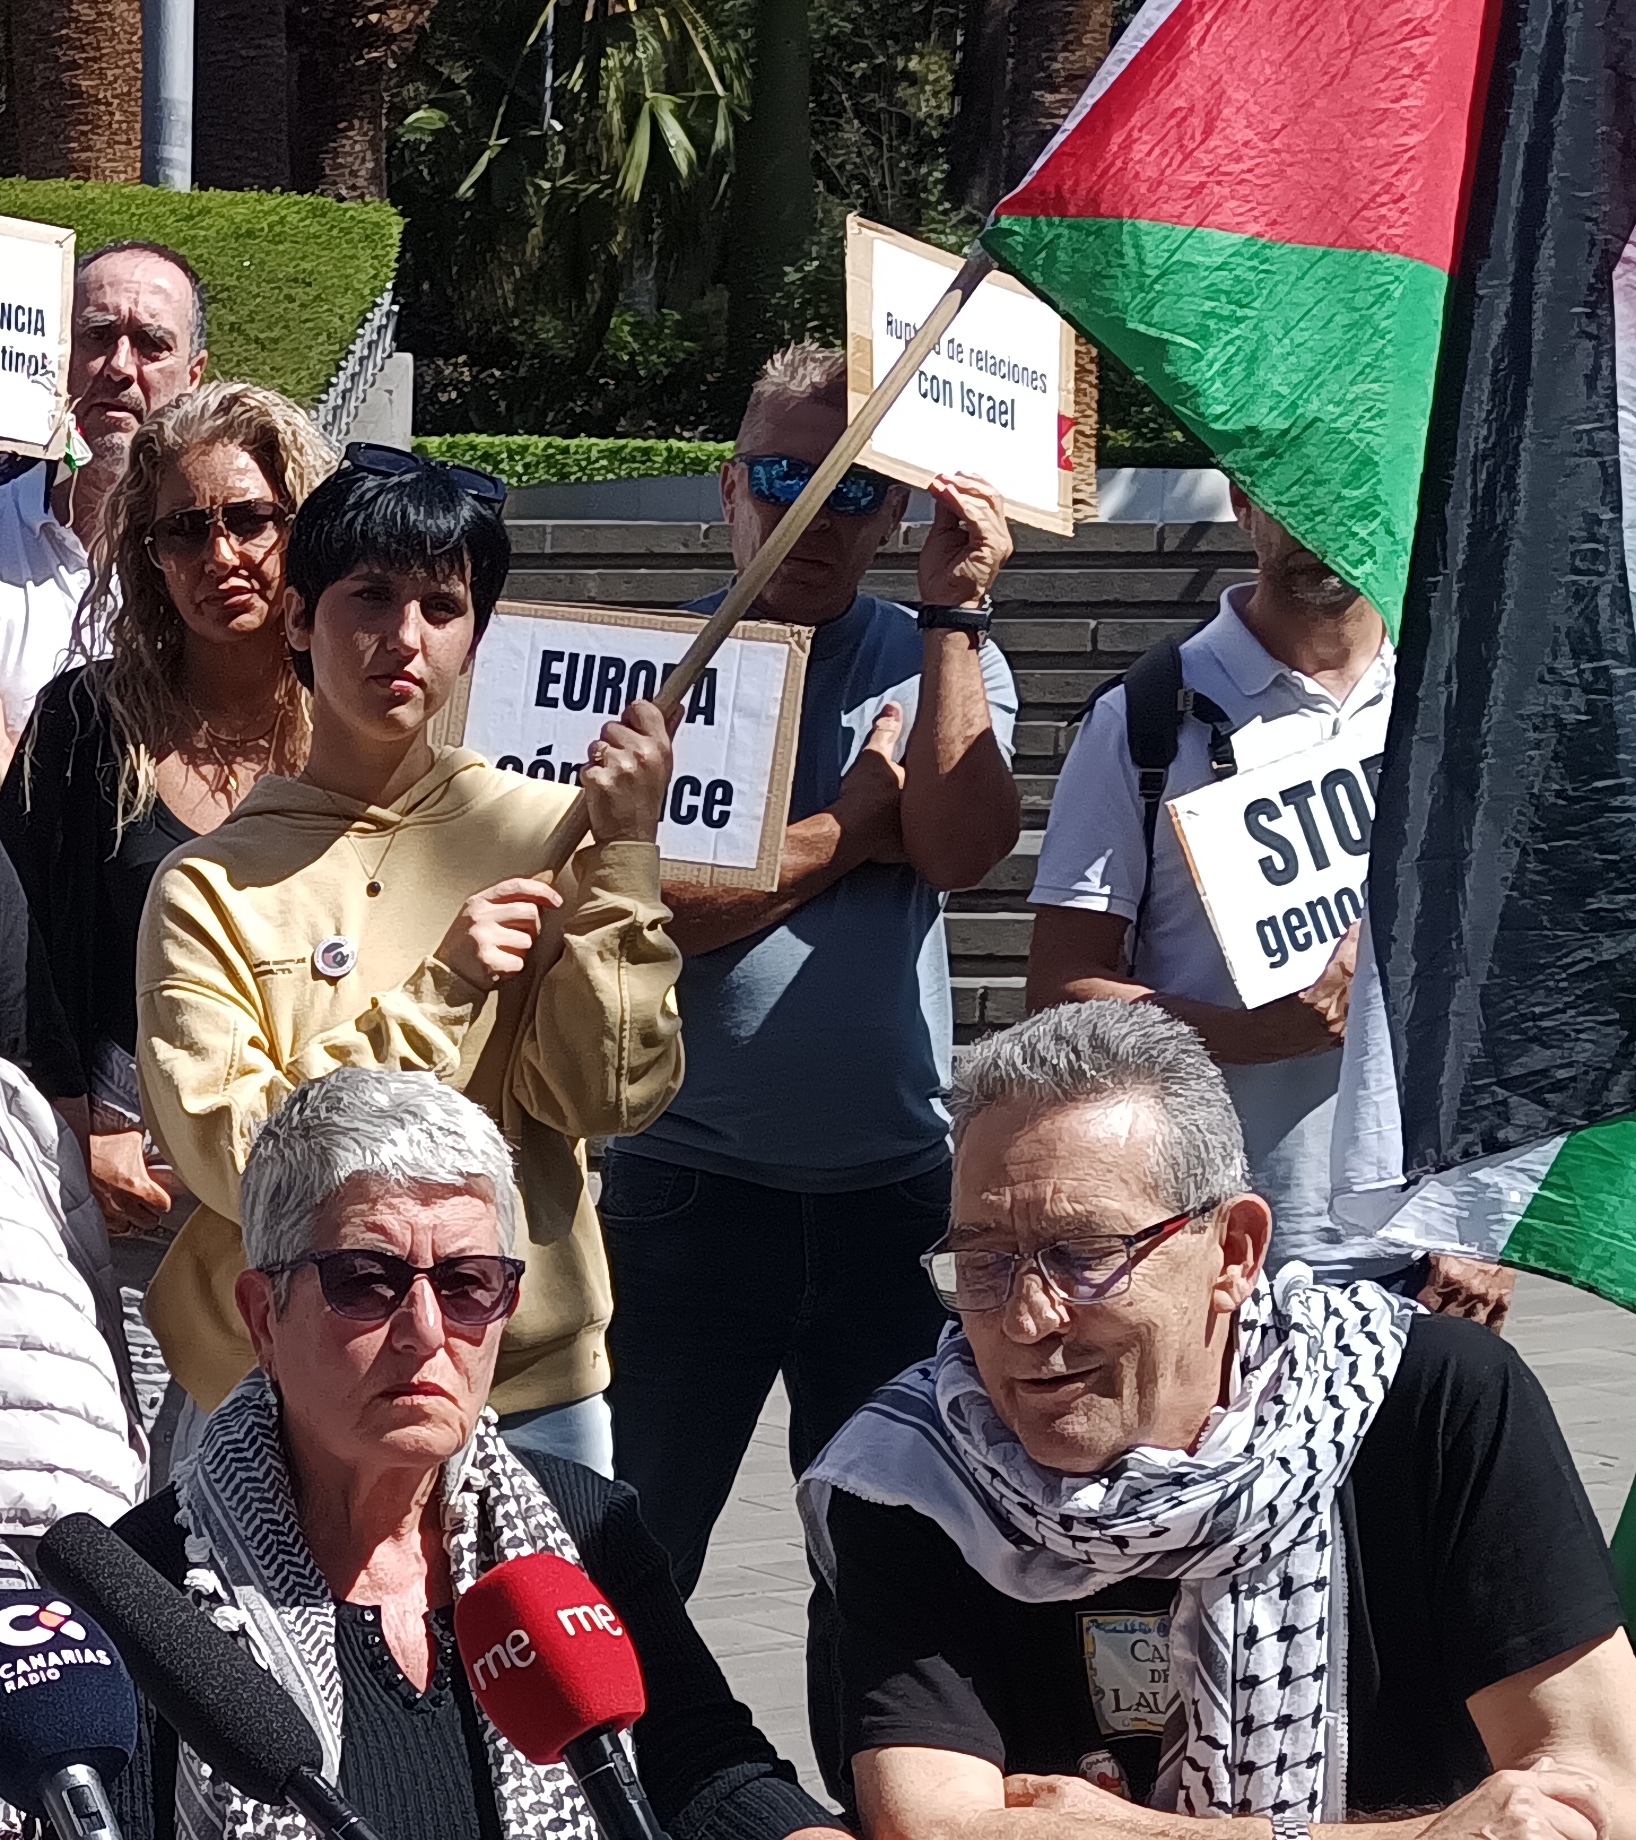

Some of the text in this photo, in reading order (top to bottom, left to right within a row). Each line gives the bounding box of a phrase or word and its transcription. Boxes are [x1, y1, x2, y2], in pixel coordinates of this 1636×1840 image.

[947, 338, 964, 363] de
[969, 347, 1047, 393] relaciones
[918, 370, 1015, 431] con Israel
[1256, 879, 1369, 968] geno
[557, 1603, 623, 1637] rne
[0, 1648, 112, 1679] CANARIAS
[4, 1668, 61, 1693] RADIO
[473, 1629, 536, 1691] rne
